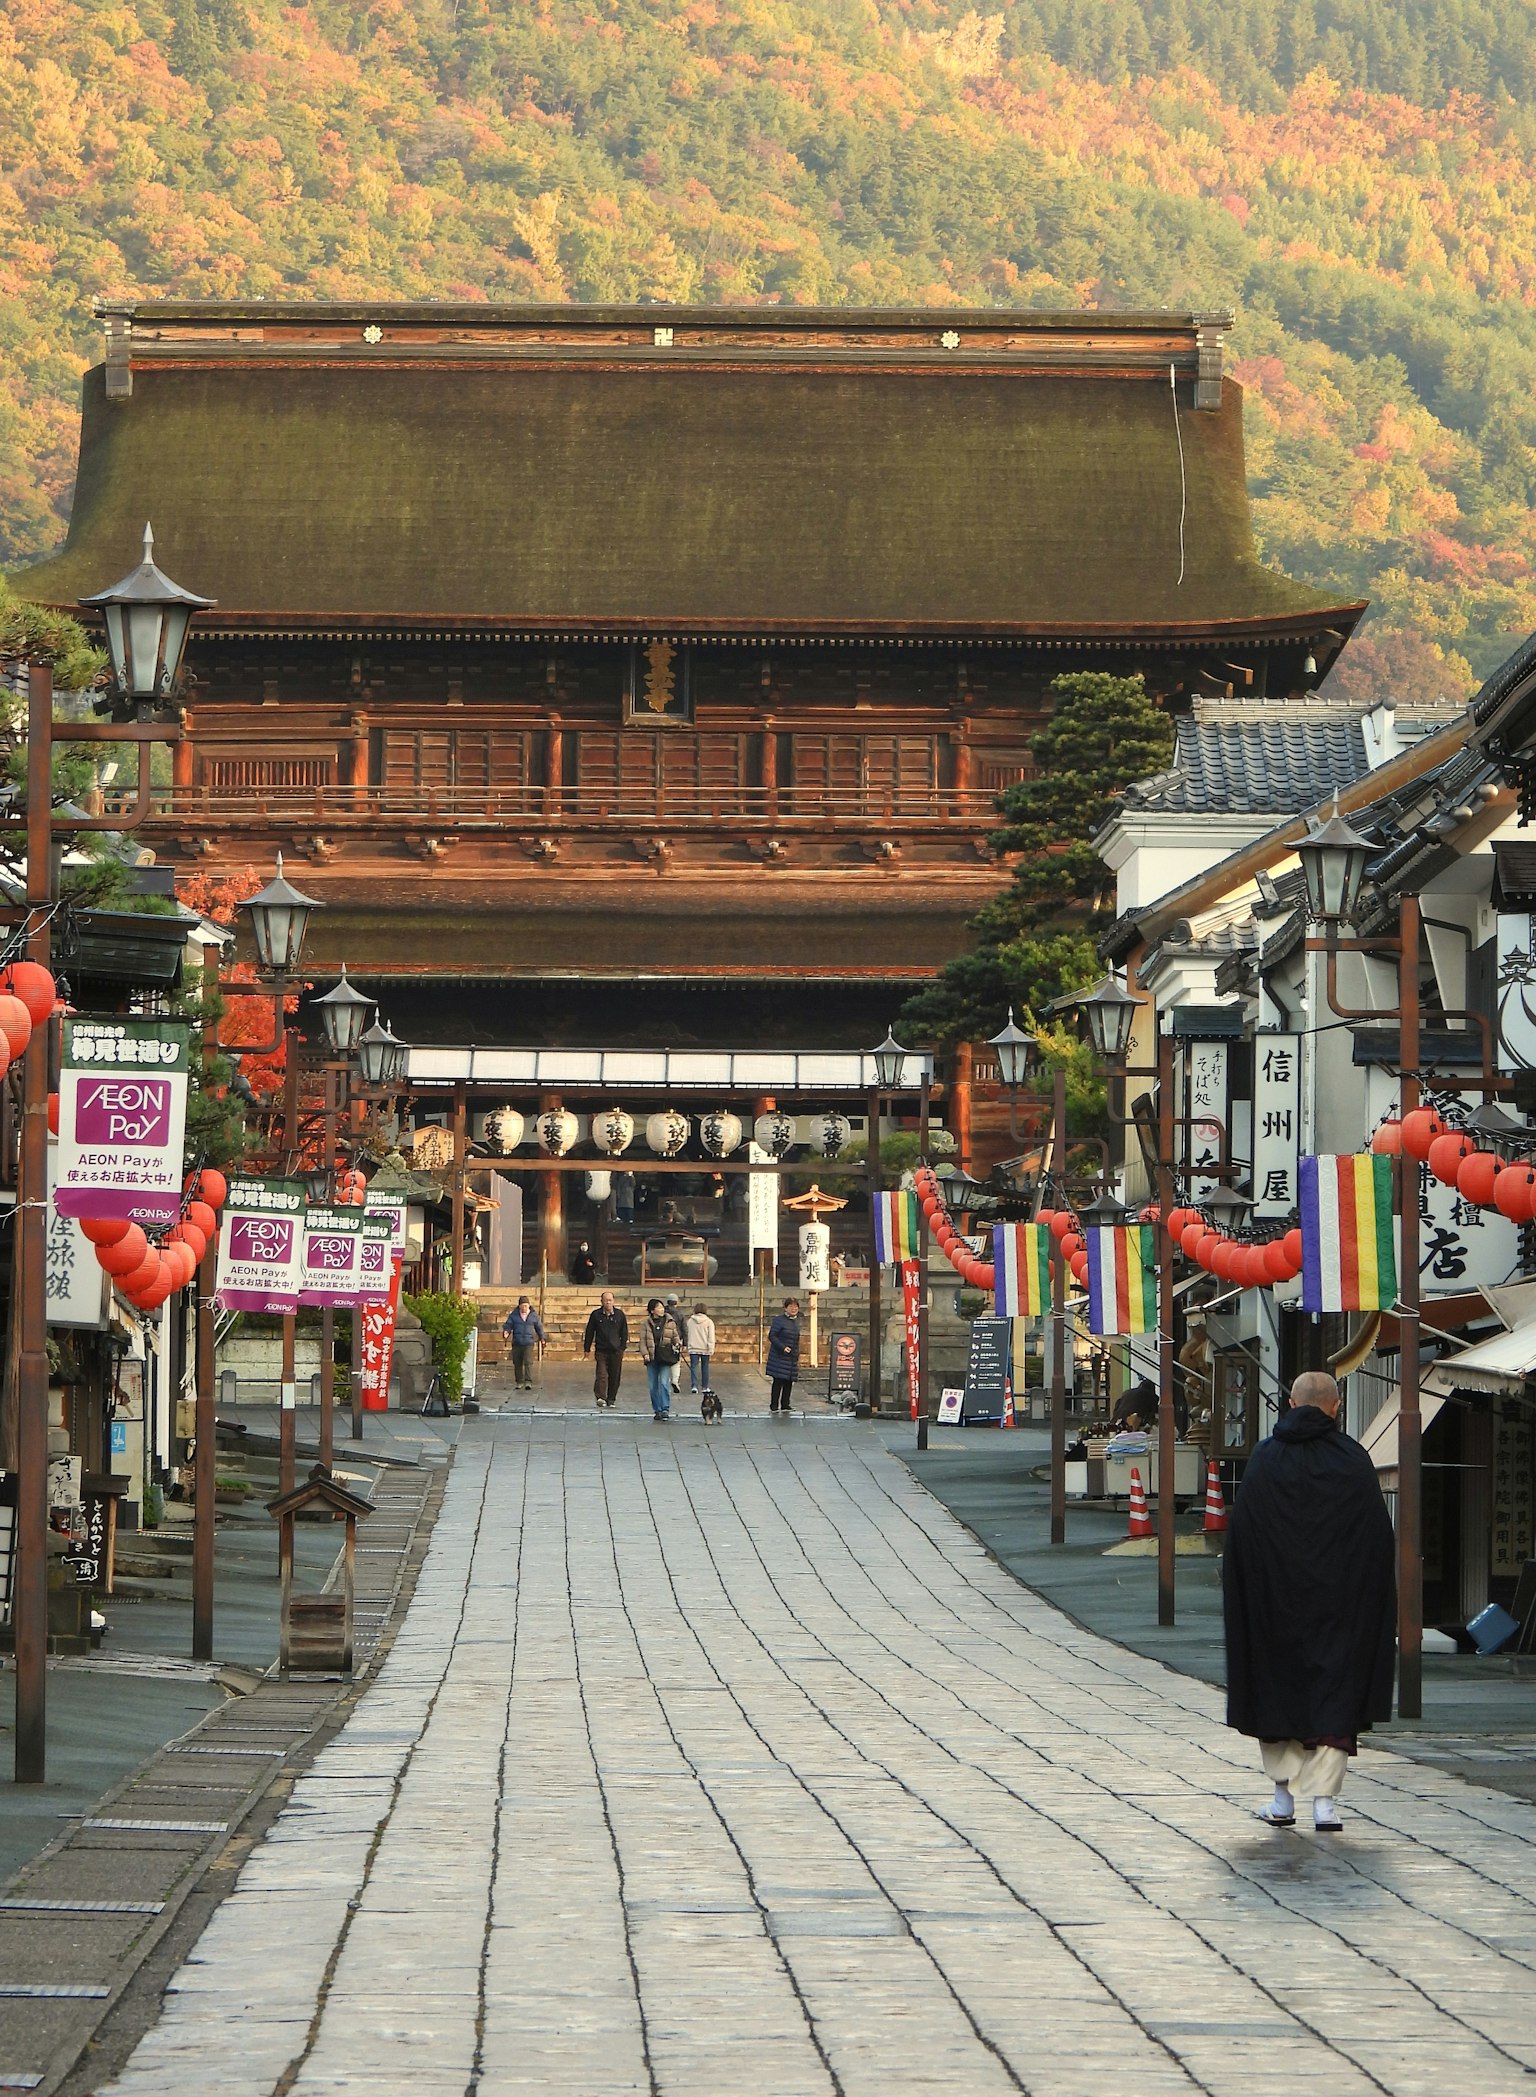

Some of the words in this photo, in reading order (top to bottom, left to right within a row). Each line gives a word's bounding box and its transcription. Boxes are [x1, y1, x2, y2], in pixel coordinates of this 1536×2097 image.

[72, 1038, 181, 1064] 仲見世通り
[1261, 1049, 1293, 1202] 信州屋
[78, 1154, 118, 1166] AEON
[67, 1170, 174, 1186] 使えるお店拡大中!
[230, 1266, 258, 1275] AEON
[90, 1499, 103, 1556] とんかつと
